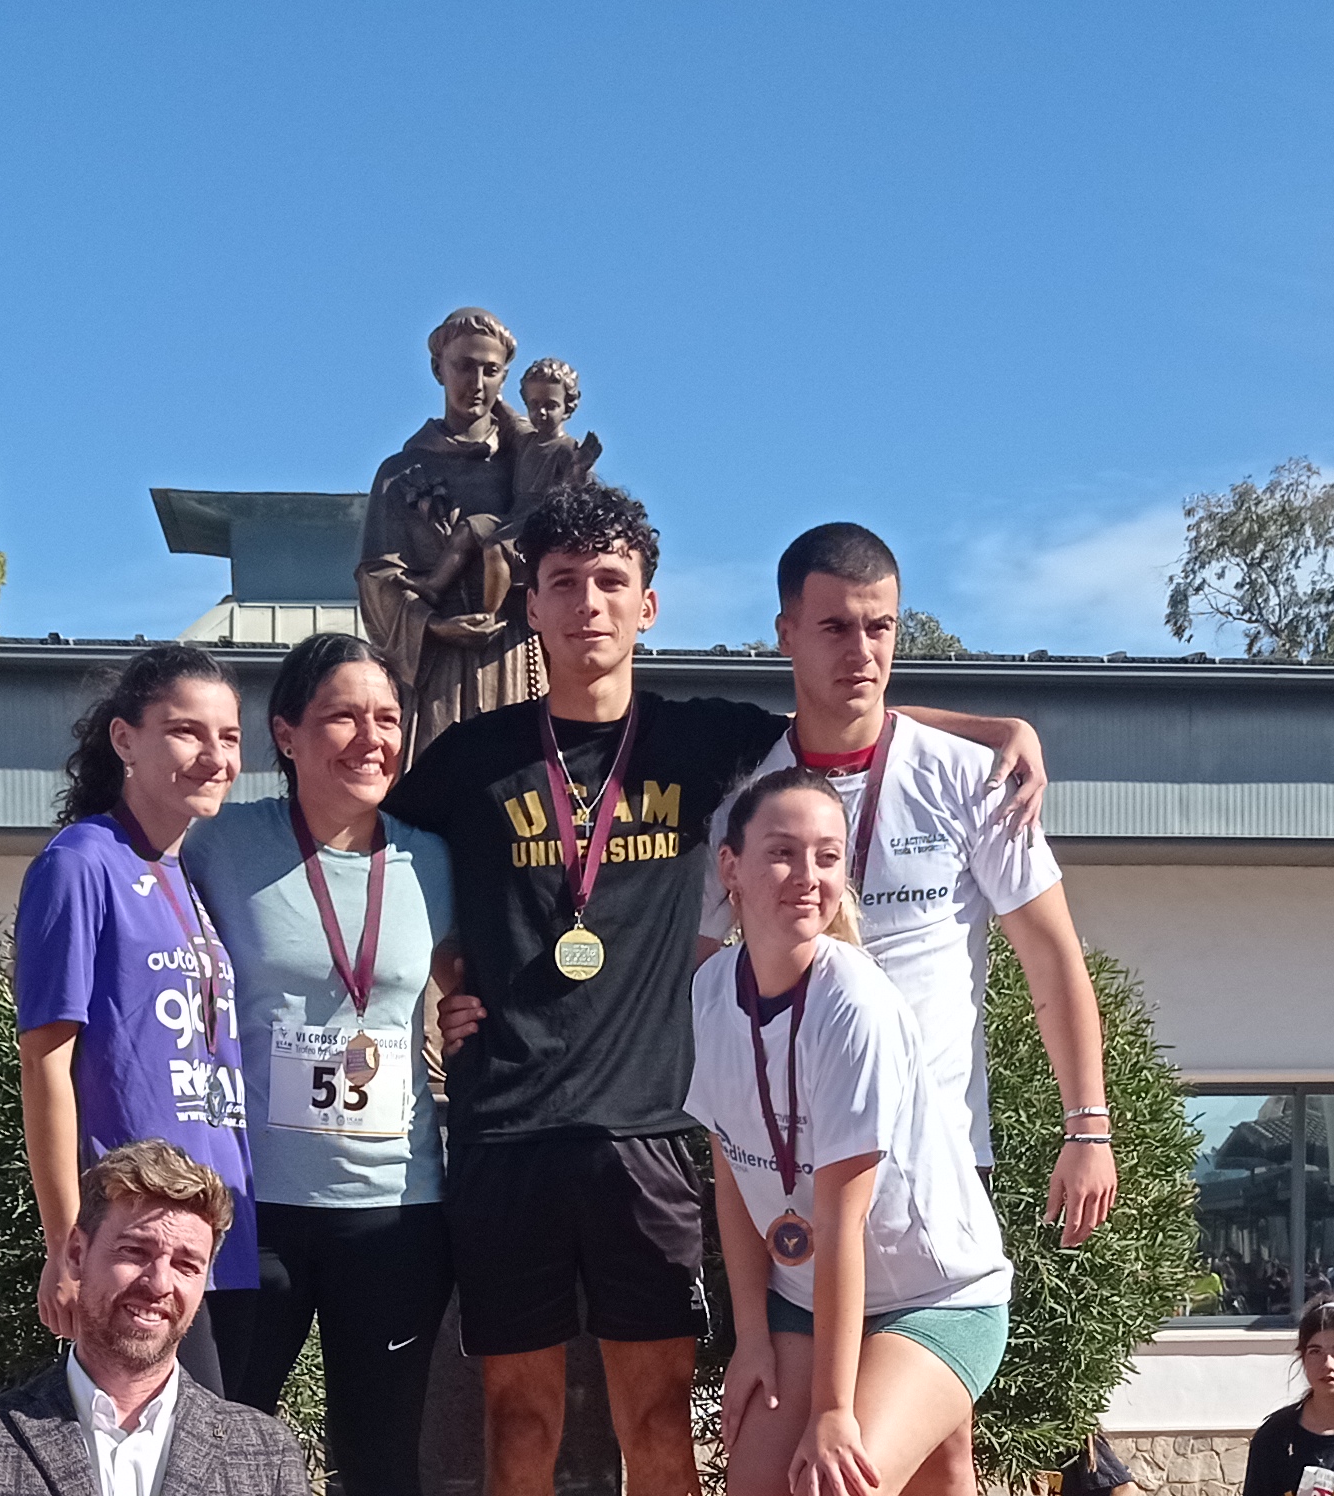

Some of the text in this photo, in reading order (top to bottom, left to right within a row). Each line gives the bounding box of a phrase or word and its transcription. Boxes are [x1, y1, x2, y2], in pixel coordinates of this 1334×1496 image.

[296, 1032, 306, 1042] VI
[308, 1034, 338, 1045] CROSS
[311, 1066, 369, 1111] 53
